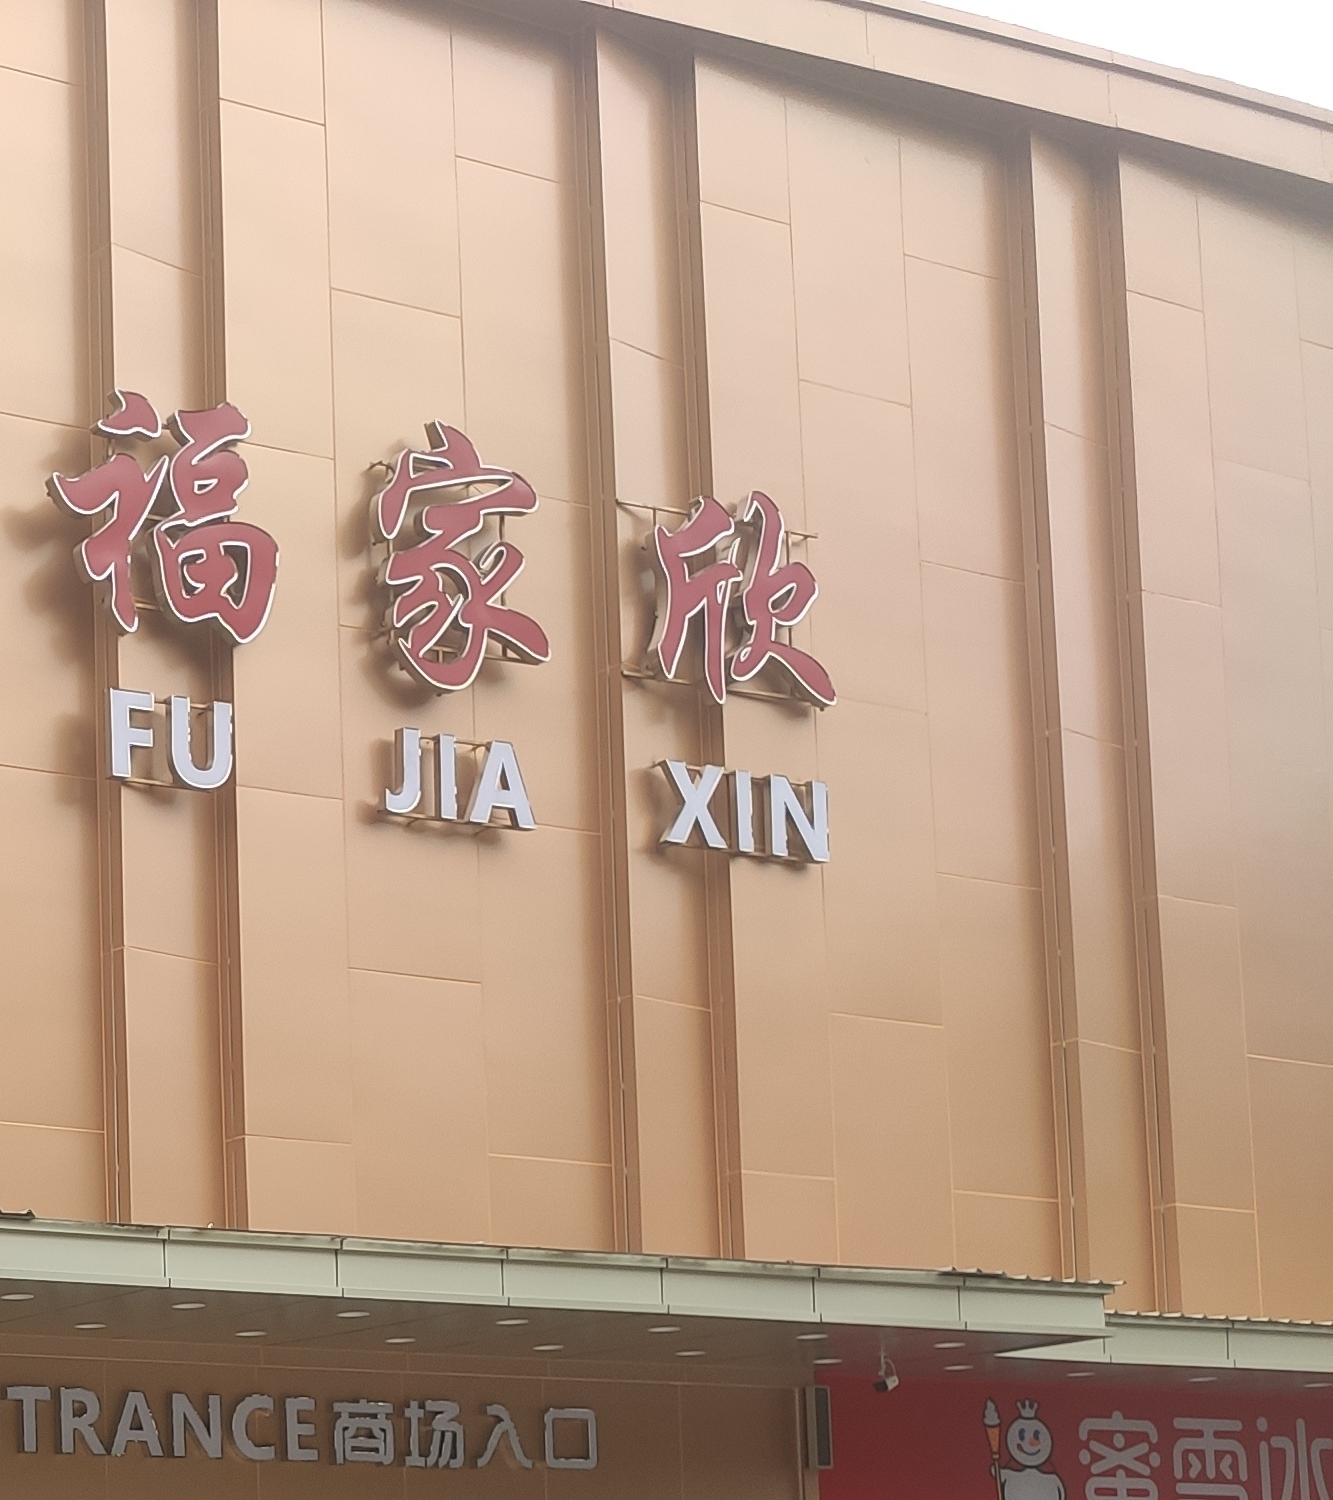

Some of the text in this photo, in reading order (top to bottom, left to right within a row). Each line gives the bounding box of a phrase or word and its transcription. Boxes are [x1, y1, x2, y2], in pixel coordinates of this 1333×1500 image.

[46, 388, 838, 706] 福家欣
[108, 686, 831, 863] FU JIA XIN
[333, 1400, 599, 1470] 商场入口
